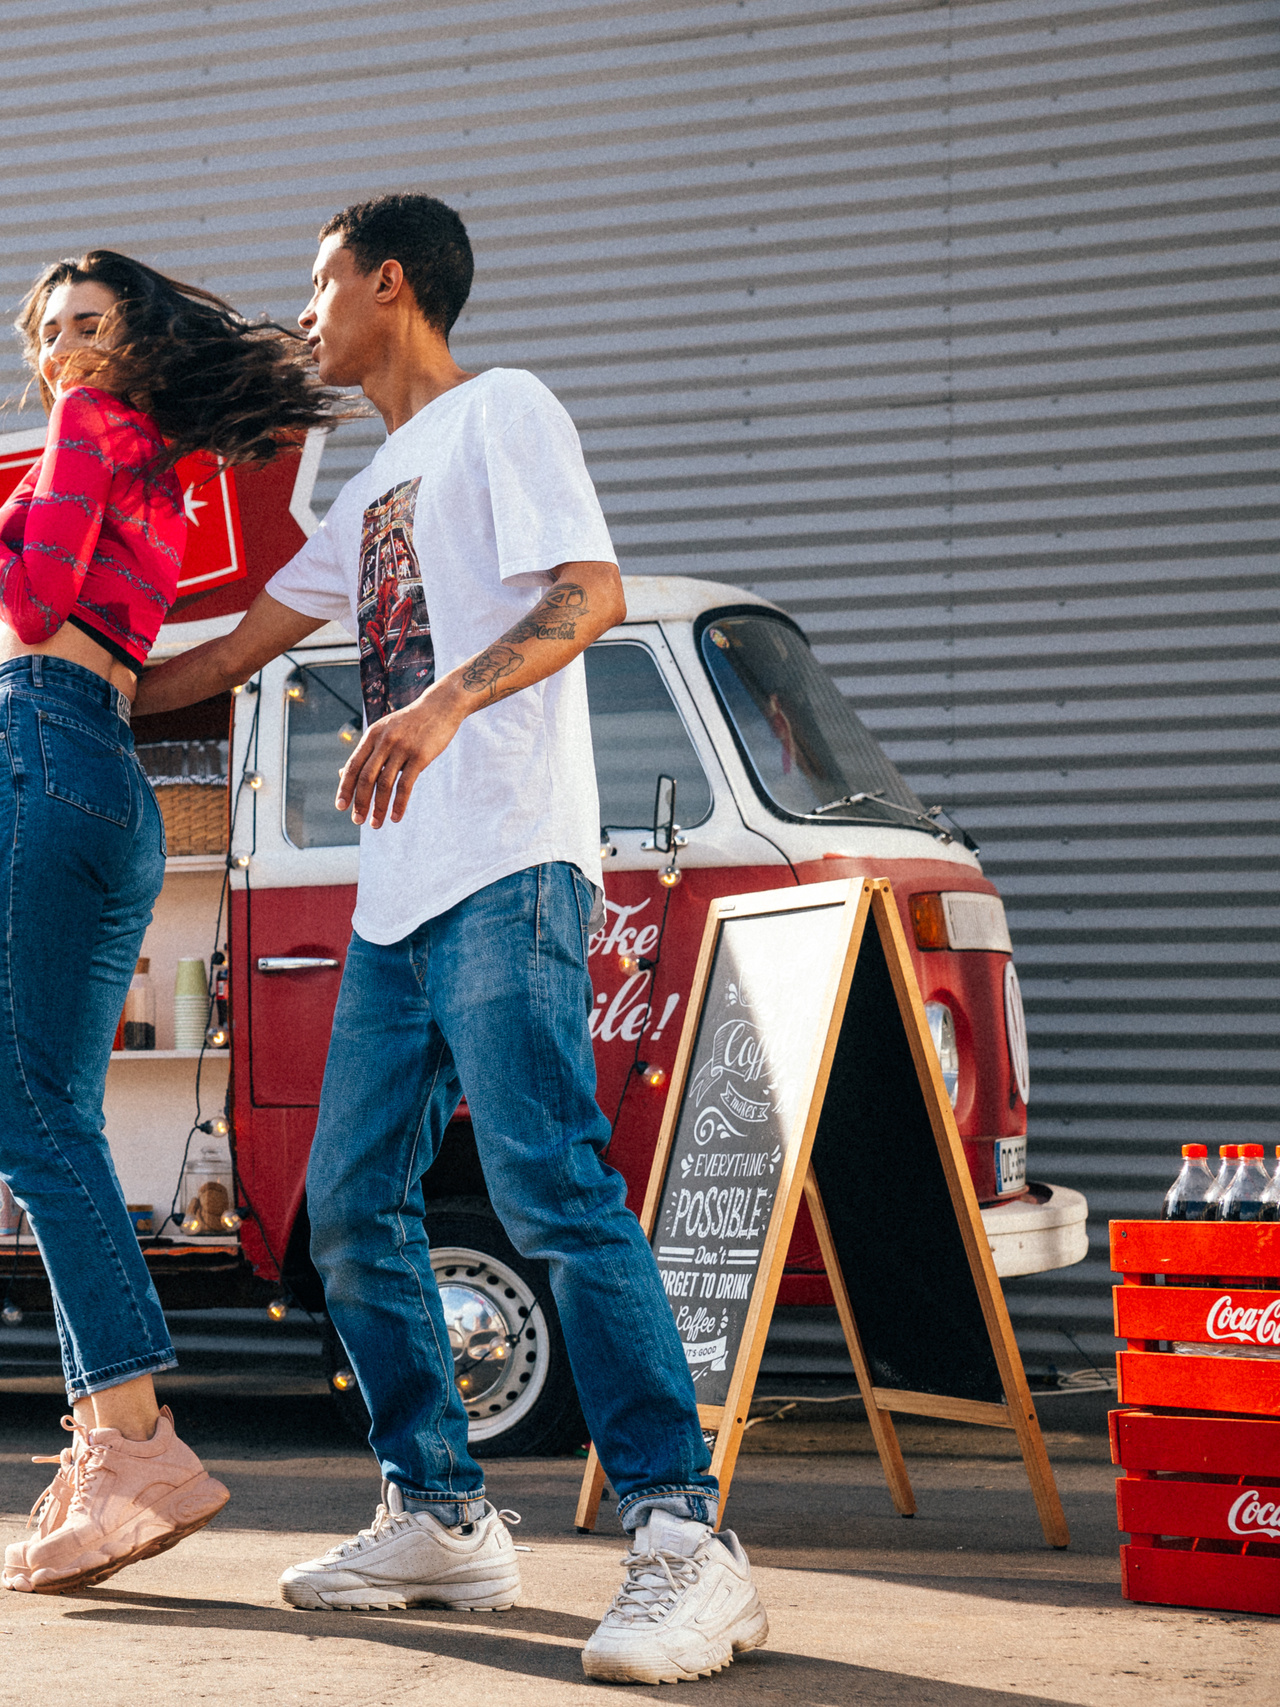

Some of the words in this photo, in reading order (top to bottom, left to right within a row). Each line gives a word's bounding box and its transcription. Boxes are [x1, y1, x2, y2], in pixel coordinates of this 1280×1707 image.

[588, 897, 659, 957] oke
[587, 969, 680, 1042] ile!
[730, 1095, 758, 1119] makes
[694, 1152, 769, 1177] EVERYTHING
[670, 1186, 768, 1240] POSSIBLE
[694, 1245, 727, 1265] Don't
[660, 1270, 700, 1297] ORGET
[700, 1273, 717, 1299] TO
[715, 1273, 752, 1300] DRINK
[676, 1305, 716, 1341] Coffee
[699, 1345, 717, 1357] GOOD
